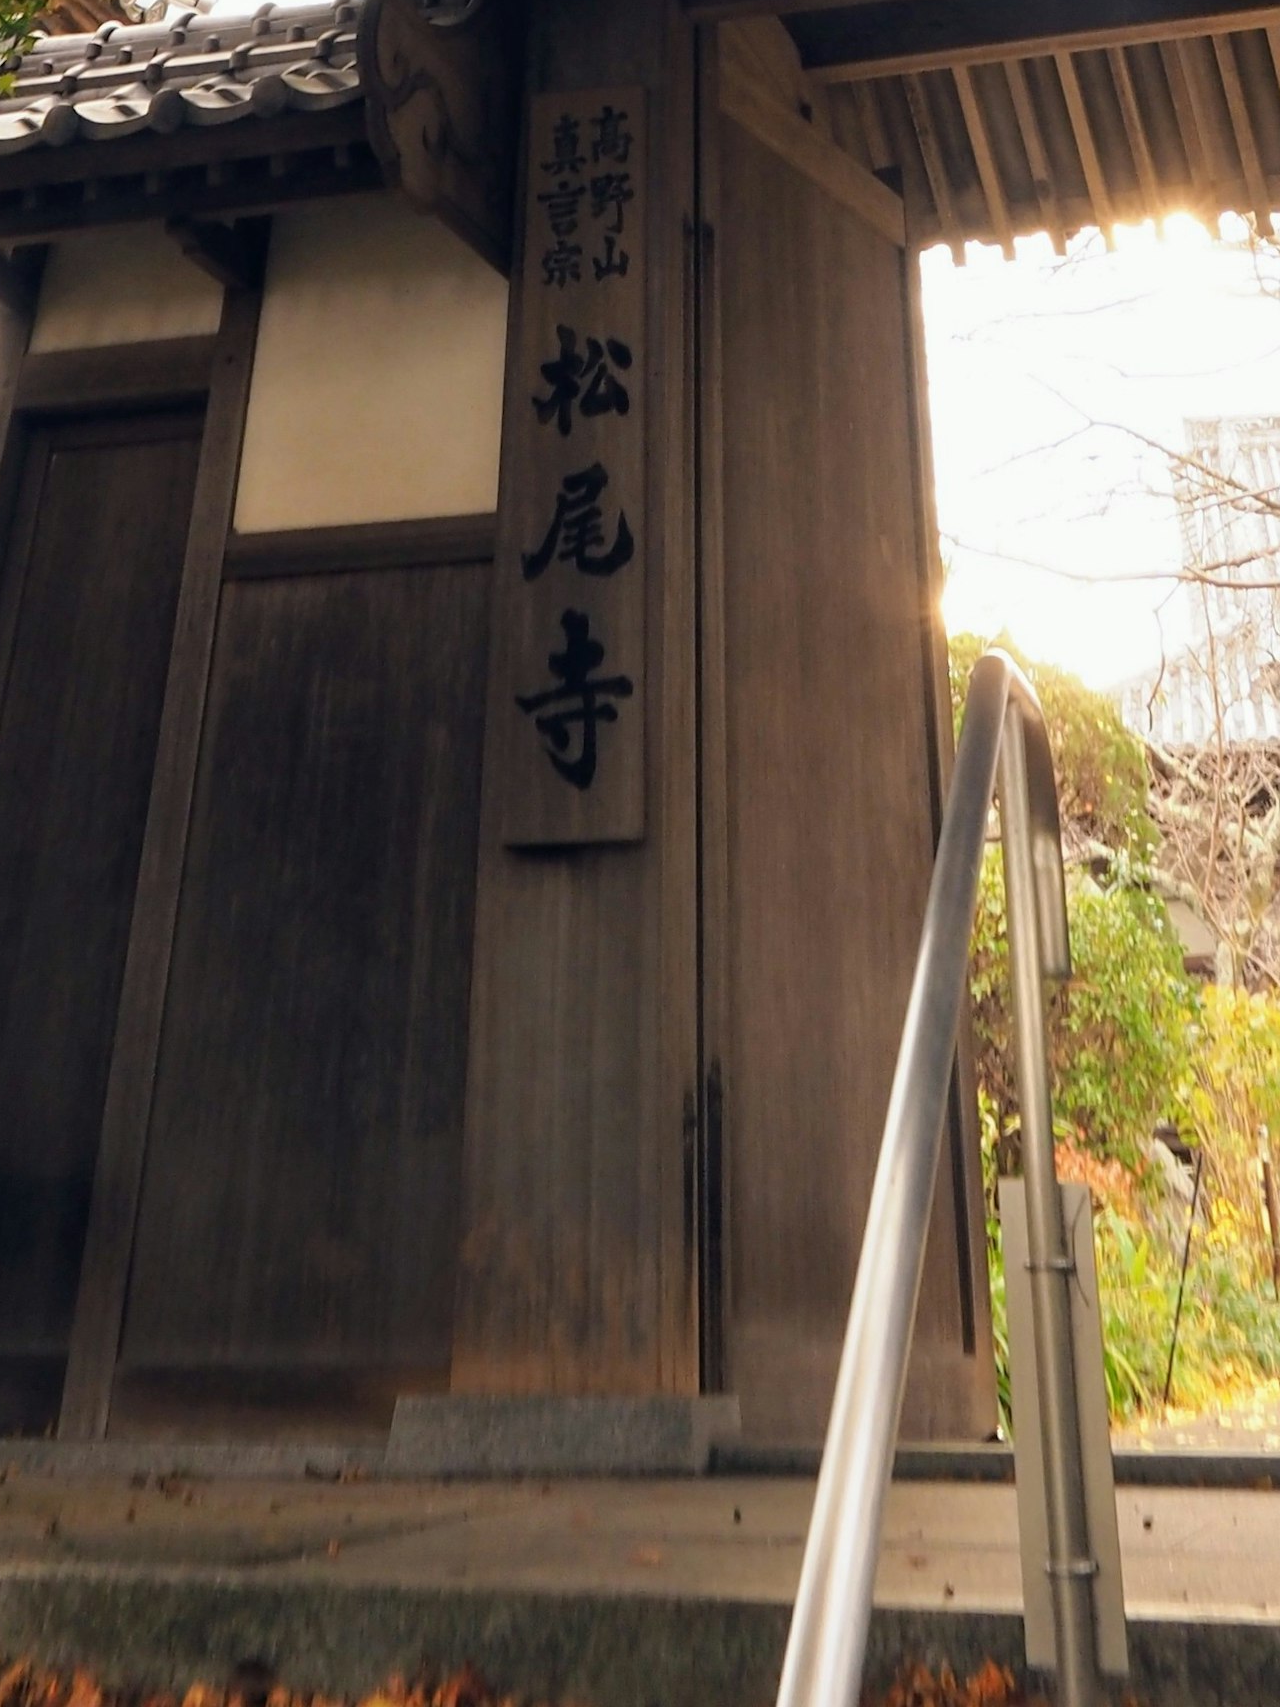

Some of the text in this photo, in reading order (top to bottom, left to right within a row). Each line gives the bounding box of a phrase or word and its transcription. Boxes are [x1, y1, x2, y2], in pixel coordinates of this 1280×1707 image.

[537, 112, 586, 289] 真言宗
[590, 105, 635, 282] 高野山
[514, 324, 634, 791] 松尾寺
